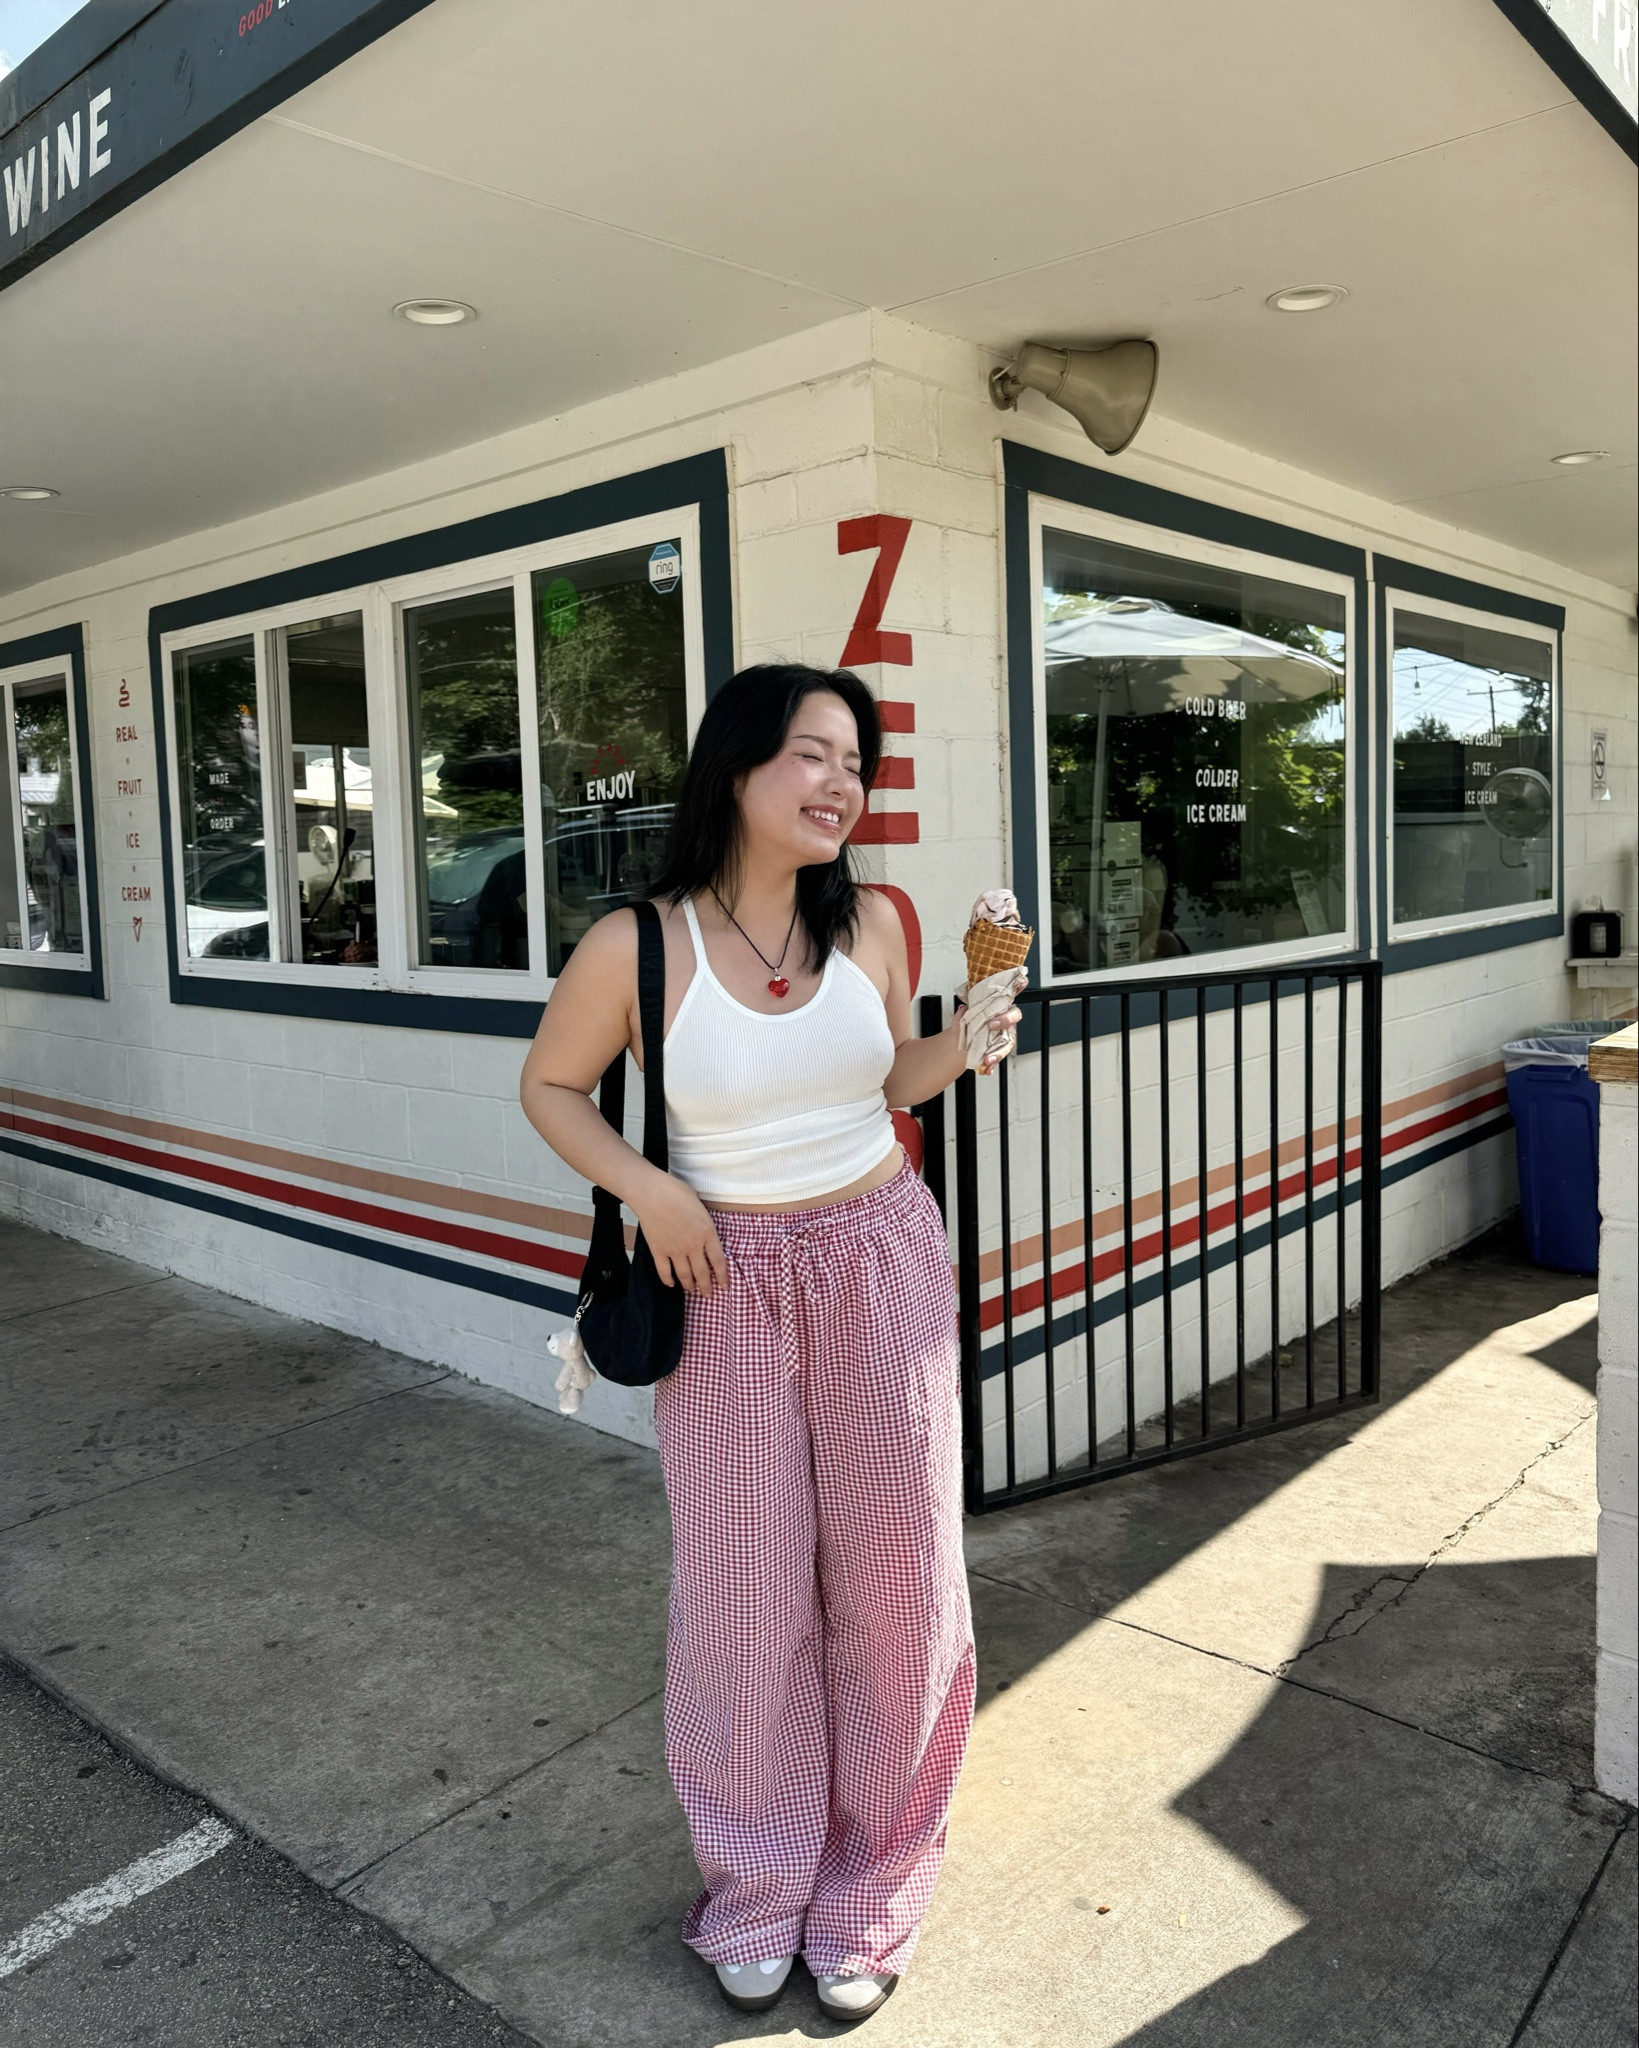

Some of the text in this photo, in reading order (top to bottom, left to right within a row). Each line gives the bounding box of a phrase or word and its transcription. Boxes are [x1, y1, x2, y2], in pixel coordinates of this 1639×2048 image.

[239, 0, 273, 37] GOOD
[3, 87, 111, 237] WINE
[655, 561, 674, 576] ring
[1185, 696, 1247, 720] COLD BEER
[116, 725, 138, 743] REAL
[1195, 768, 1239, 788] COLDER
[1472, 761, 1491, 777] STYLE
[118, 778, 142, 796] FRUIT
[209, 773, 230, 785] MADE
[586, 770, 636, 801] ENJOY
[1464, 790, 1498, 805] ICE CREAM
[1186, 803, 1247, 823] ICE CREAM
[210, 817, 234, 830] ORDER
[126, 833, 140, 849] ICE
[122, 886, 151, 902] CREAM
